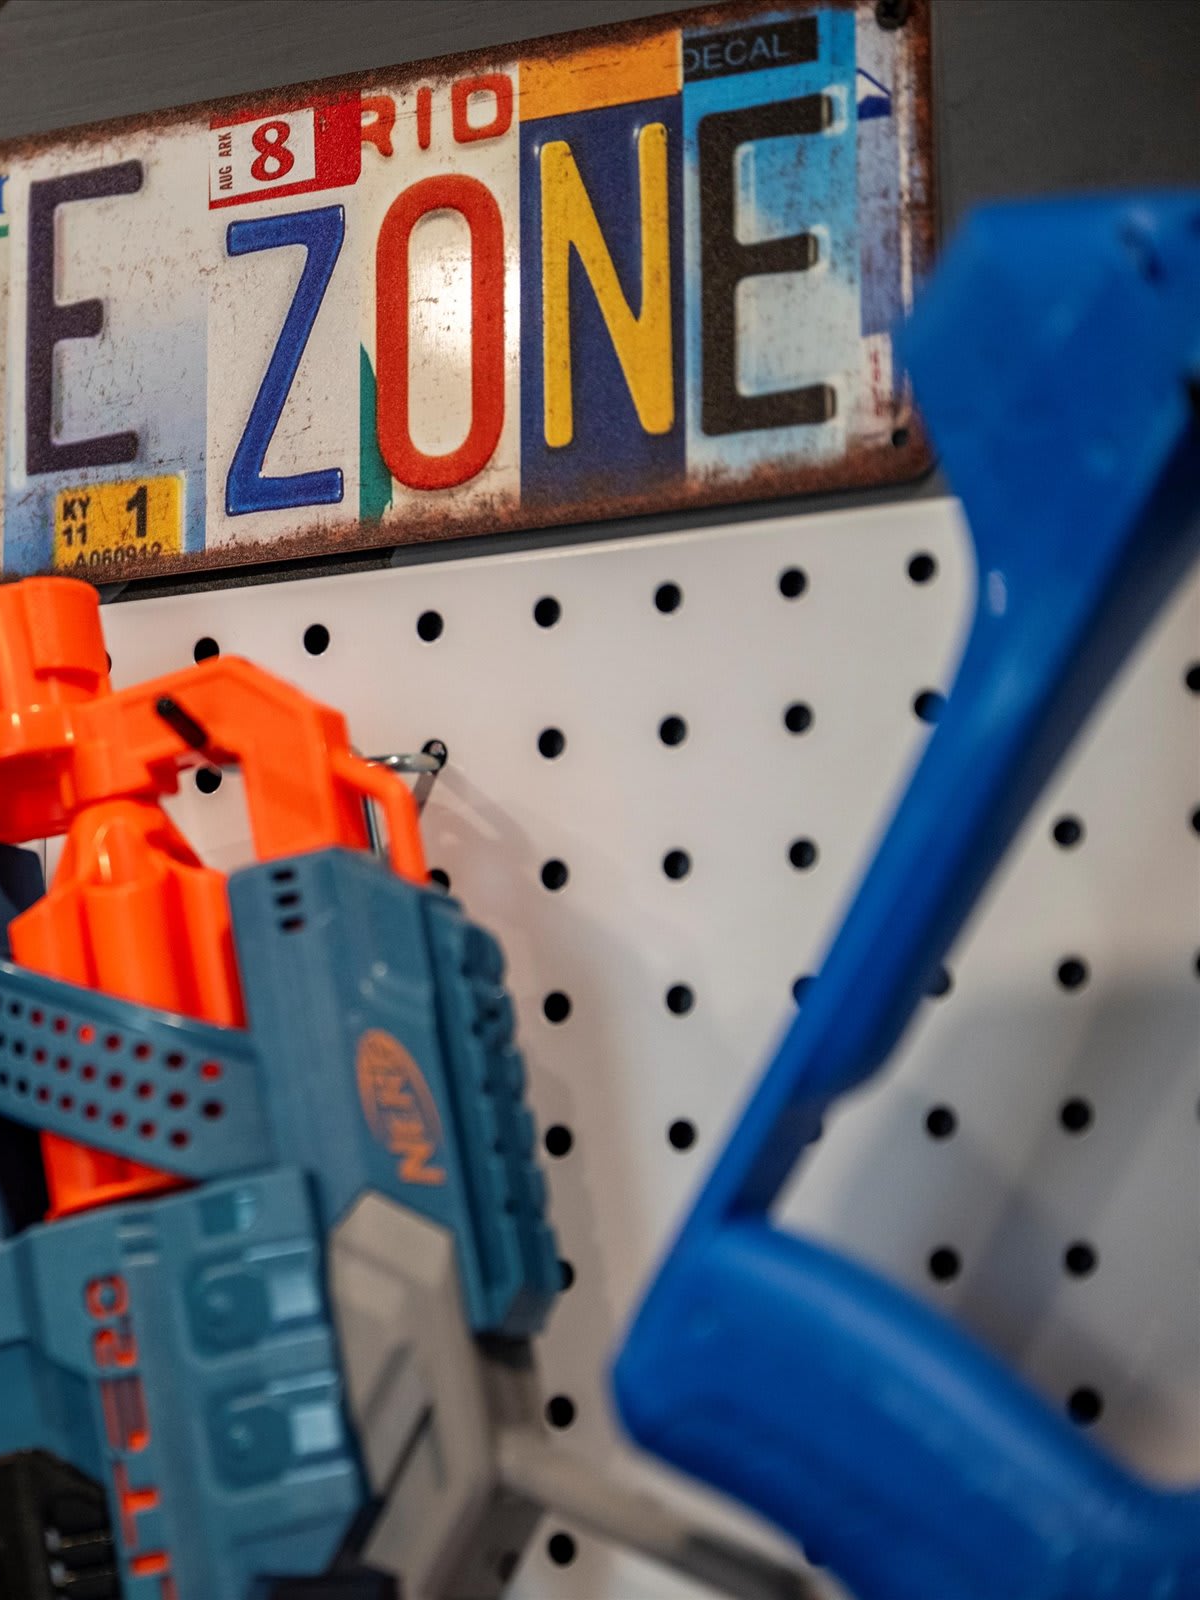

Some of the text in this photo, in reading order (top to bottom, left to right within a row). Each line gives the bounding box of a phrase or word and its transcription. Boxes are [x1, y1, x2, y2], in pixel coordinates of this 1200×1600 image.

[218, 131, 233, 190] AUG ARK
[250, 120, 296, 182] 8
[225, 92, 838, 518] ZONE
[62, 495, 91, 521] KY
[62, 523, 88, 547] 11
[126, 485, 148, 538] 1
